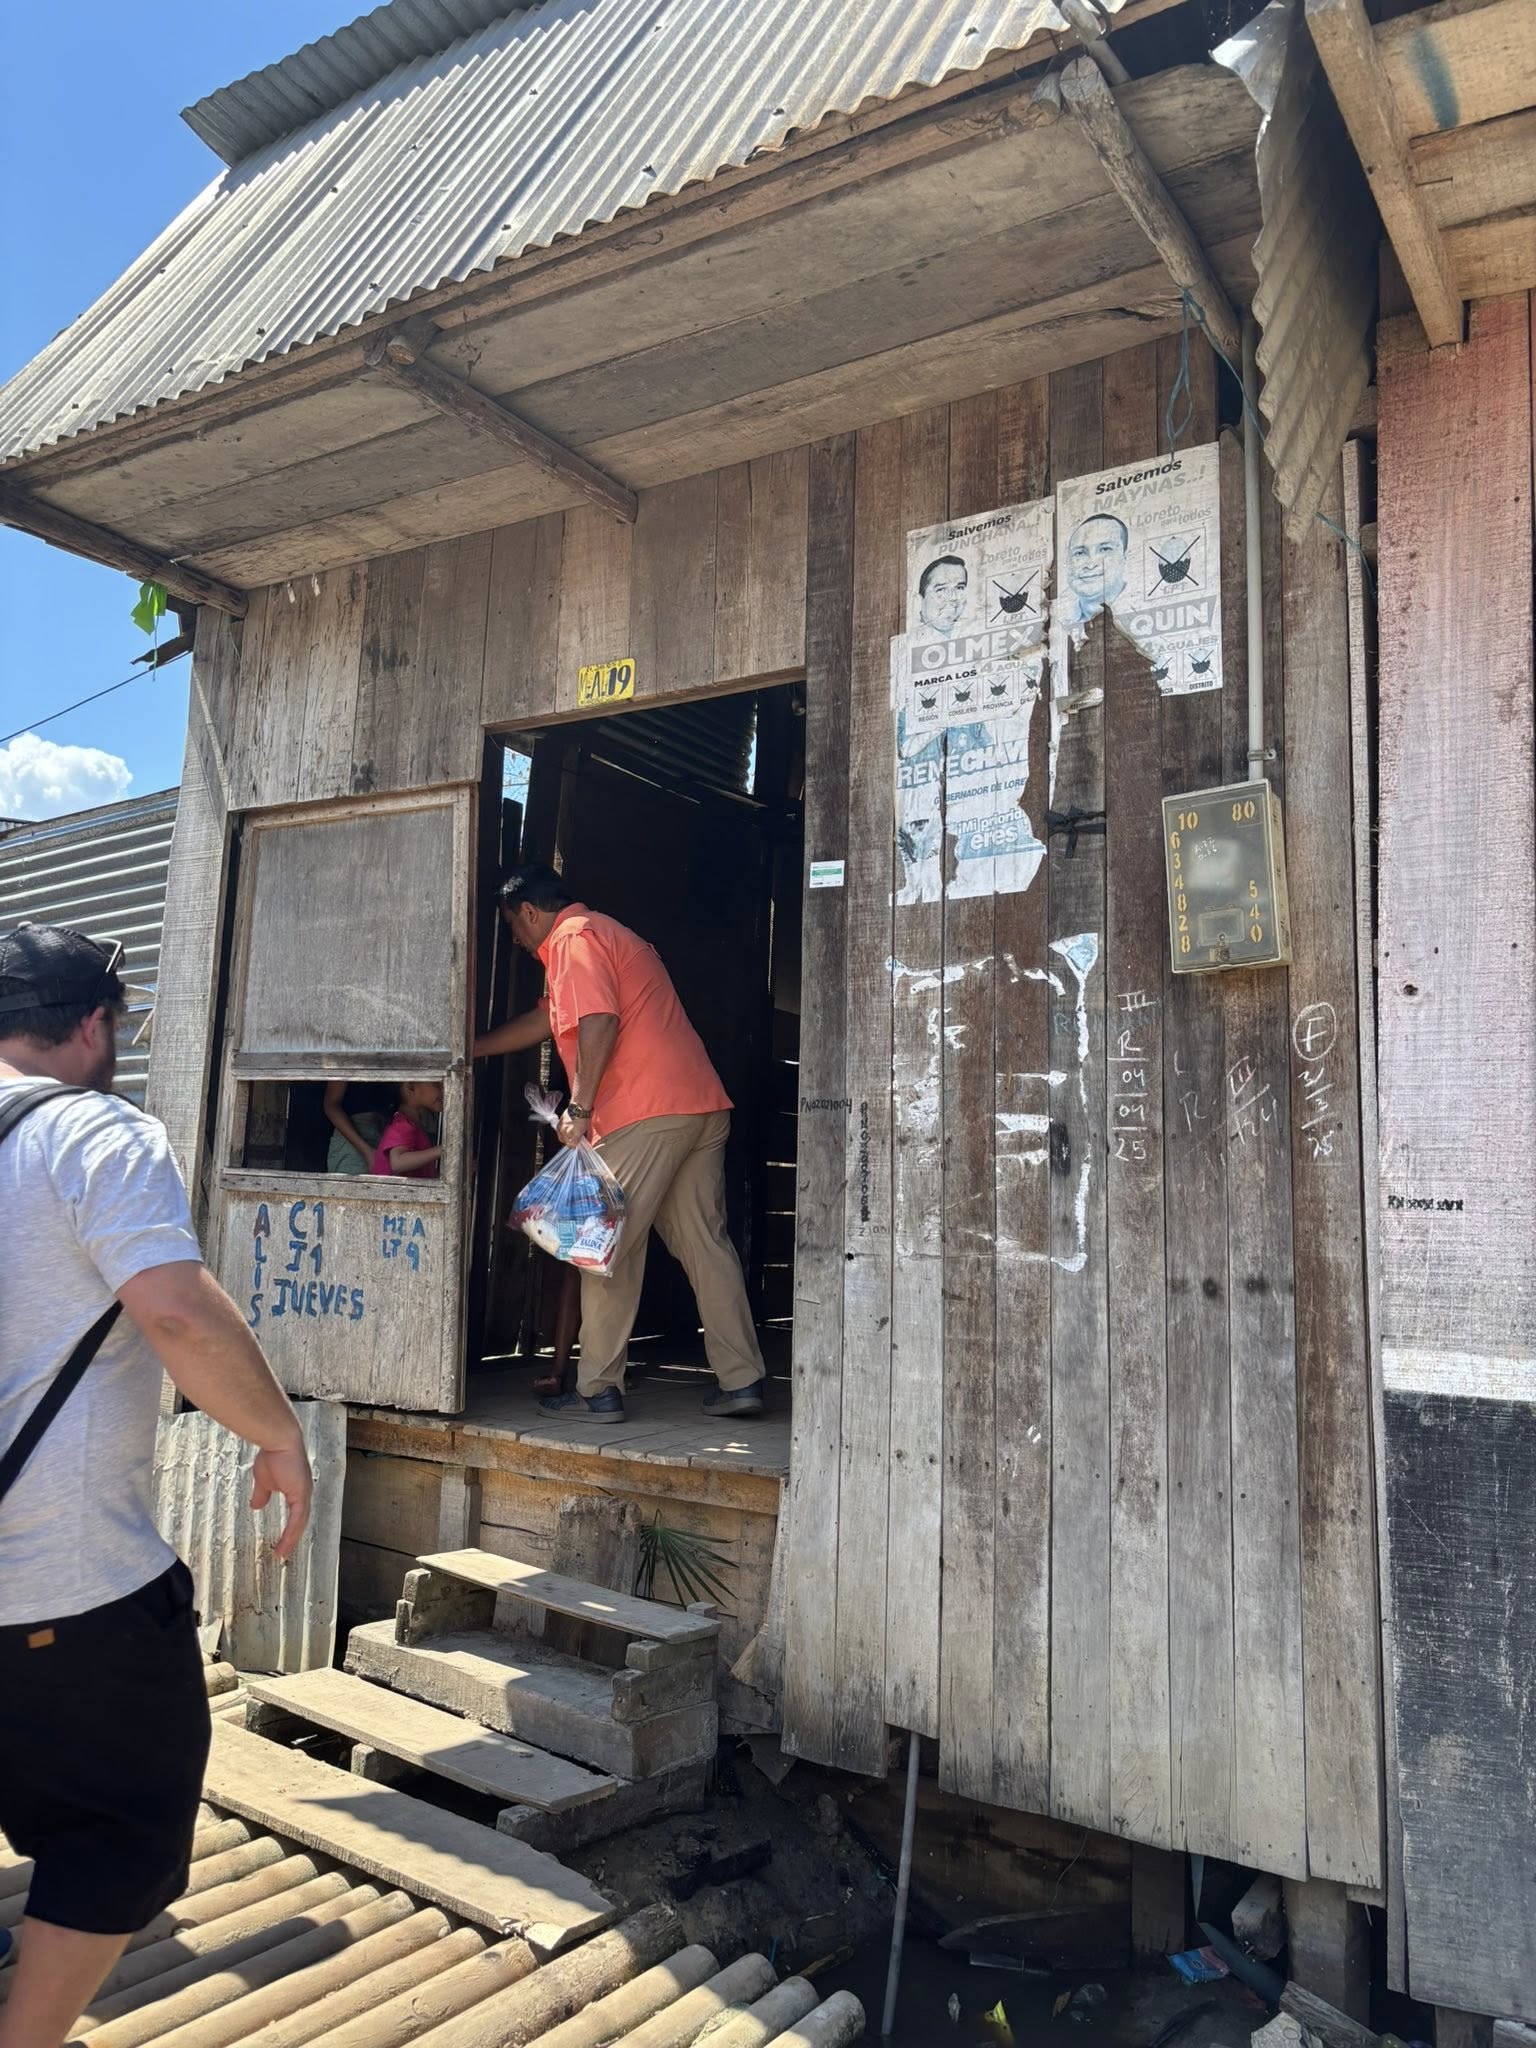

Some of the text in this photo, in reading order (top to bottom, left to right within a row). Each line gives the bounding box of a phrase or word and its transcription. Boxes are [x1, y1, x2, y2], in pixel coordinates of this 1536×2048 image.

[1096, 460, 1182, 495] Salvemos
[1136, 504, 1181, 528] Loreto
[1178, 506, 1212, 526] todos
[948, 514, 1012, 541] Salvemos
[979, 546, 1020, 566] Loreto
[1129, 601, 1209, 637] QUIN
[921, 625, 1035, 669] OLMEX
[1158, 634, 1219, 652] AGUAJES
[914, 674, 953, 688] MARCA
[955, 668, 978, 680] LOS
[947, 706, 978, 718] CONSEJERO
[982, 700, 1014, 711] PROVINCIA
[918, 713, 939, 723] REGIÓN
[990, 782, 1002, 793] DE
[1232, 800, 1255, 821] 80
[970, 824, 1019, 851] eres
[271, 1278, 364, 1321] JUEVES
